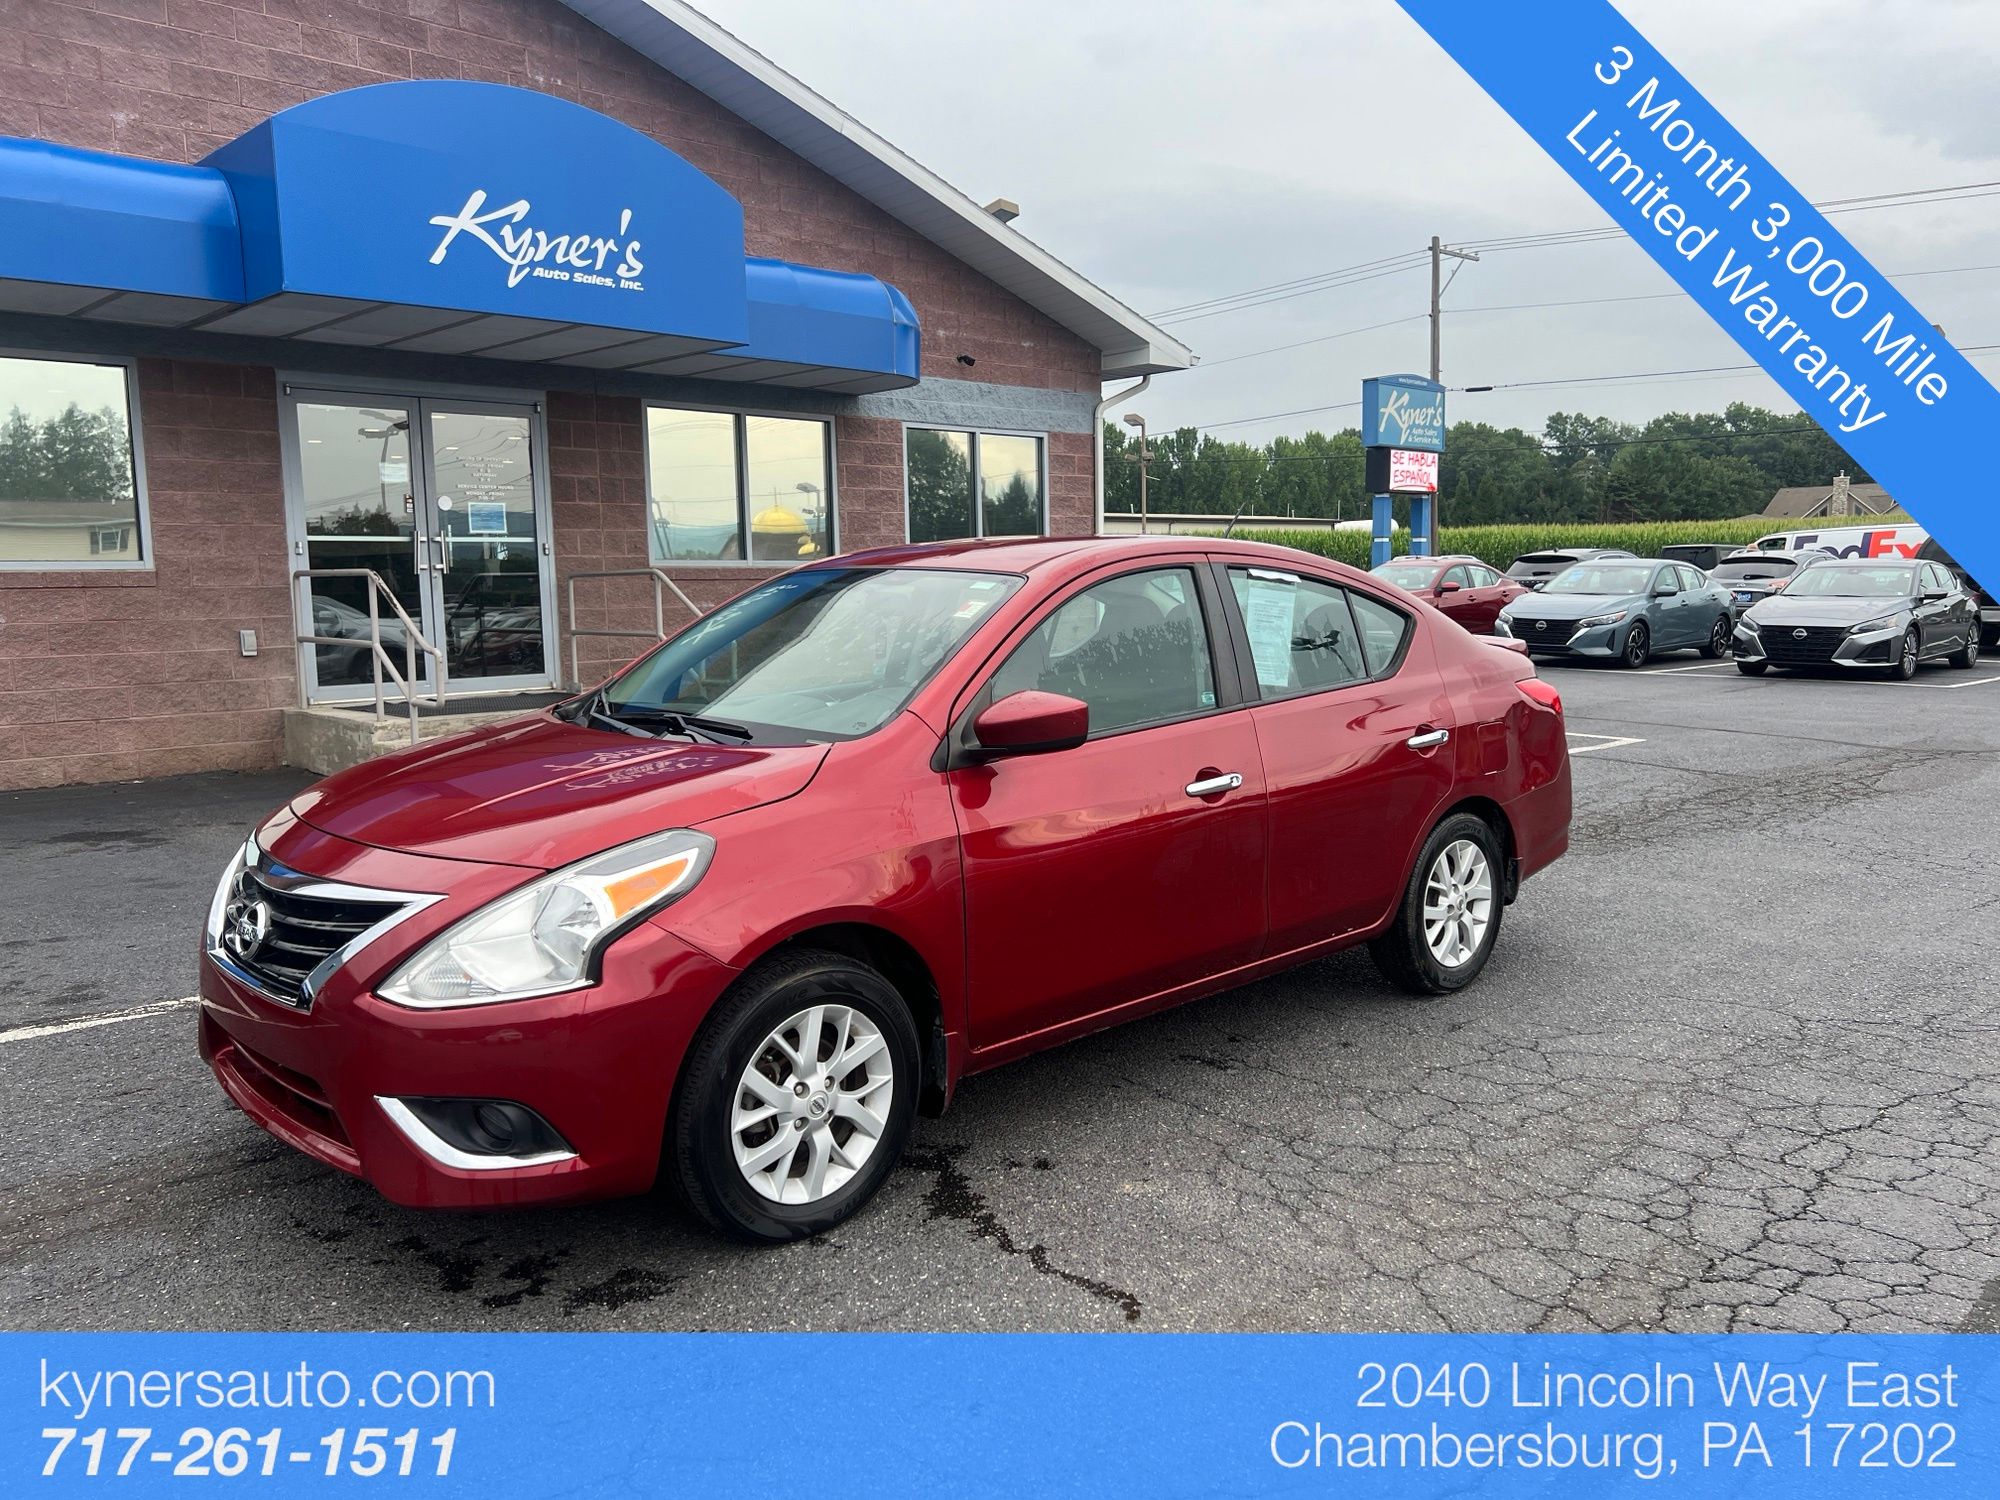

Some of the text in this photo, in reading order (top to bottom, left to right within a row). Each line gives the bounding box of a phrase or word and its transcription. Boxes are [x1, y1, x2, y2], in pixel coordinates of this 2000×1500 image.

[429, 189, 644, 288] Kyner's
[532, 267, 644, 291] Auto Sales, Inc.
[1379, 390, 1443, 445] Kyner's
[1392, 451, 1436, 468] SE HABLA
[1393, 468, 1432, 484] ESPAÑOL
